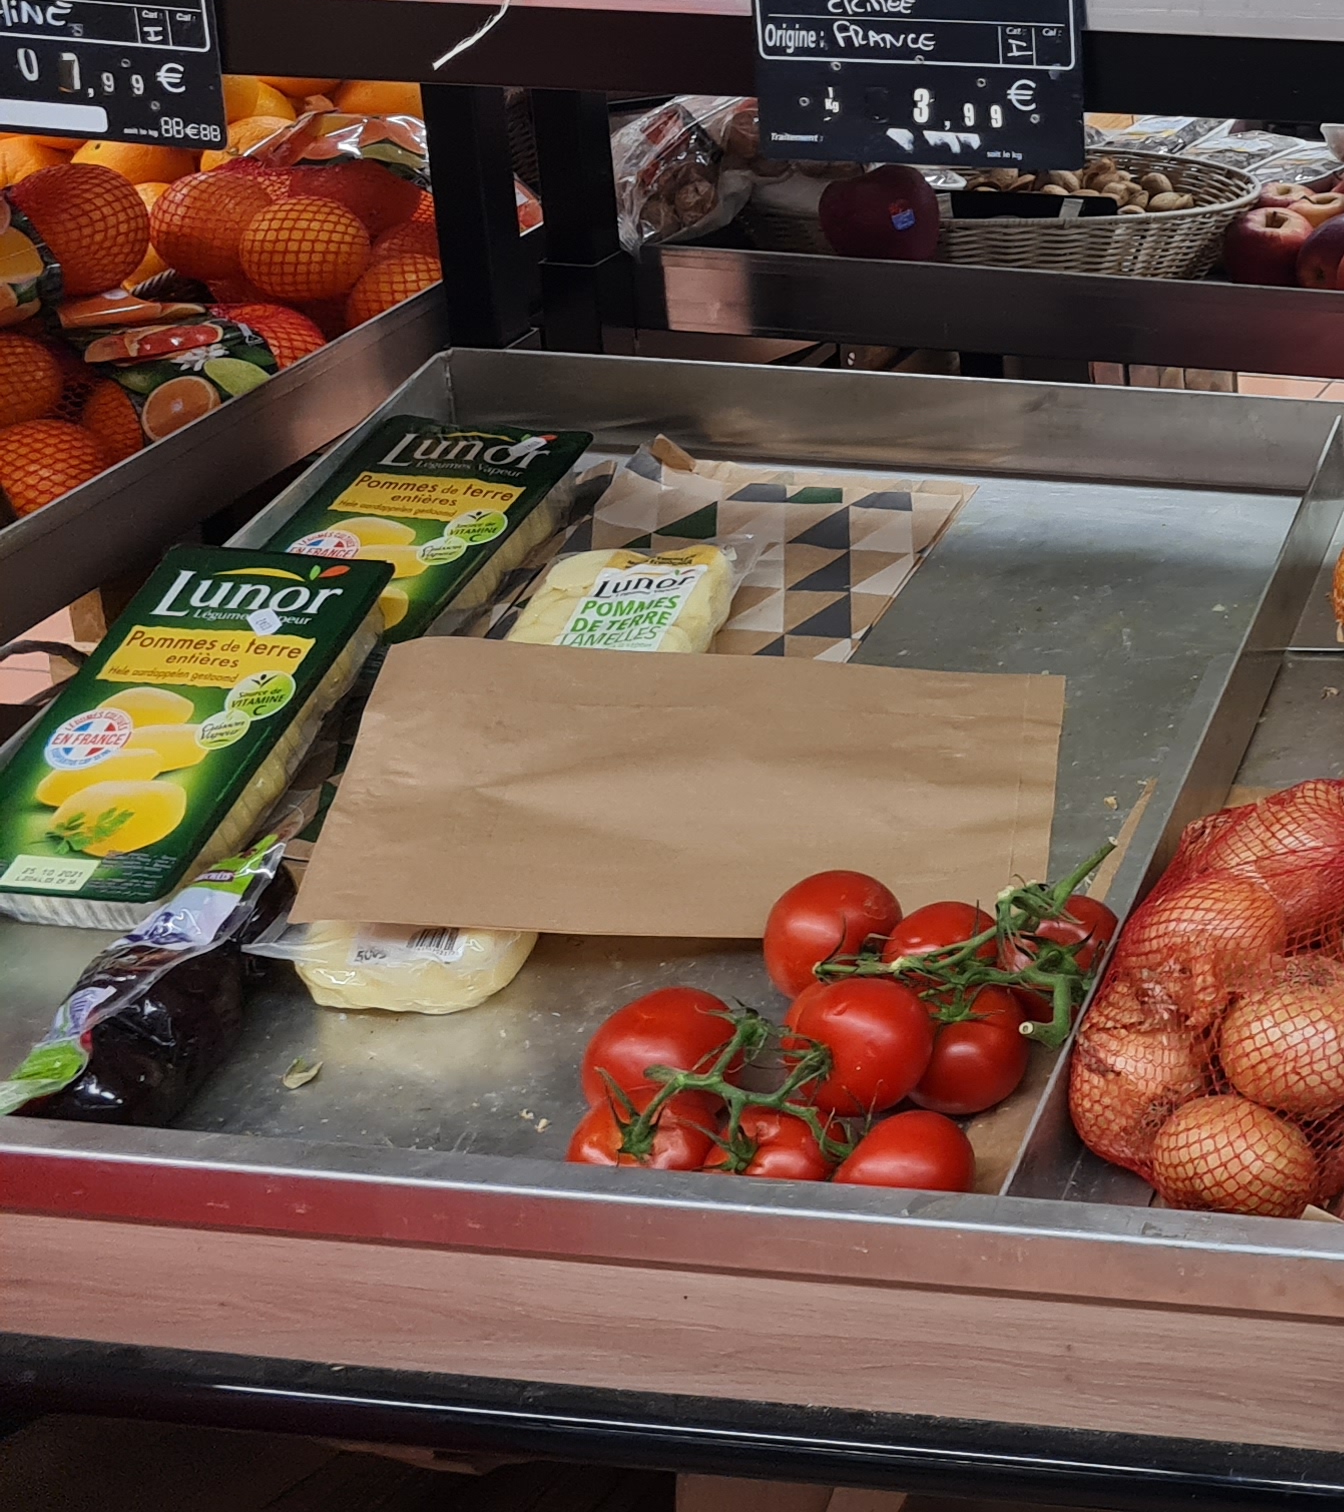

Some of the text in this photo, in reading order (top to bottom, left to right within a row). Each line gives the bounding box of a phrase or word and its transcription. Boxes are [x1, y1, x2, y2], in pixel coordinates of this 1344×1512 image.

[833, 20, 937, 52] FRANCE
[376, 432, 551, 470] Lunor
[354, 474, 438, 495] Pommes
[442, 484, 460, 495] de
[390, 492, 458, 507] entières
[150, 569, 344, 618] Lunor
[593, 575, 696, 598] Lunor
[193, 608, 249, 622] Légume
[579, 594, 682, 617] POMMES
[570, 610, 672, 633] DE TERRE
[125, 629, 219, 652] Pommes
[220, 637, 241, 653] de
[165, 651, 240, 669] entières
[230, 692, 287, 709] VITAMINE
[252, 704, 269, 717] C
[51, 731, 123, 747] EN FRANCE
